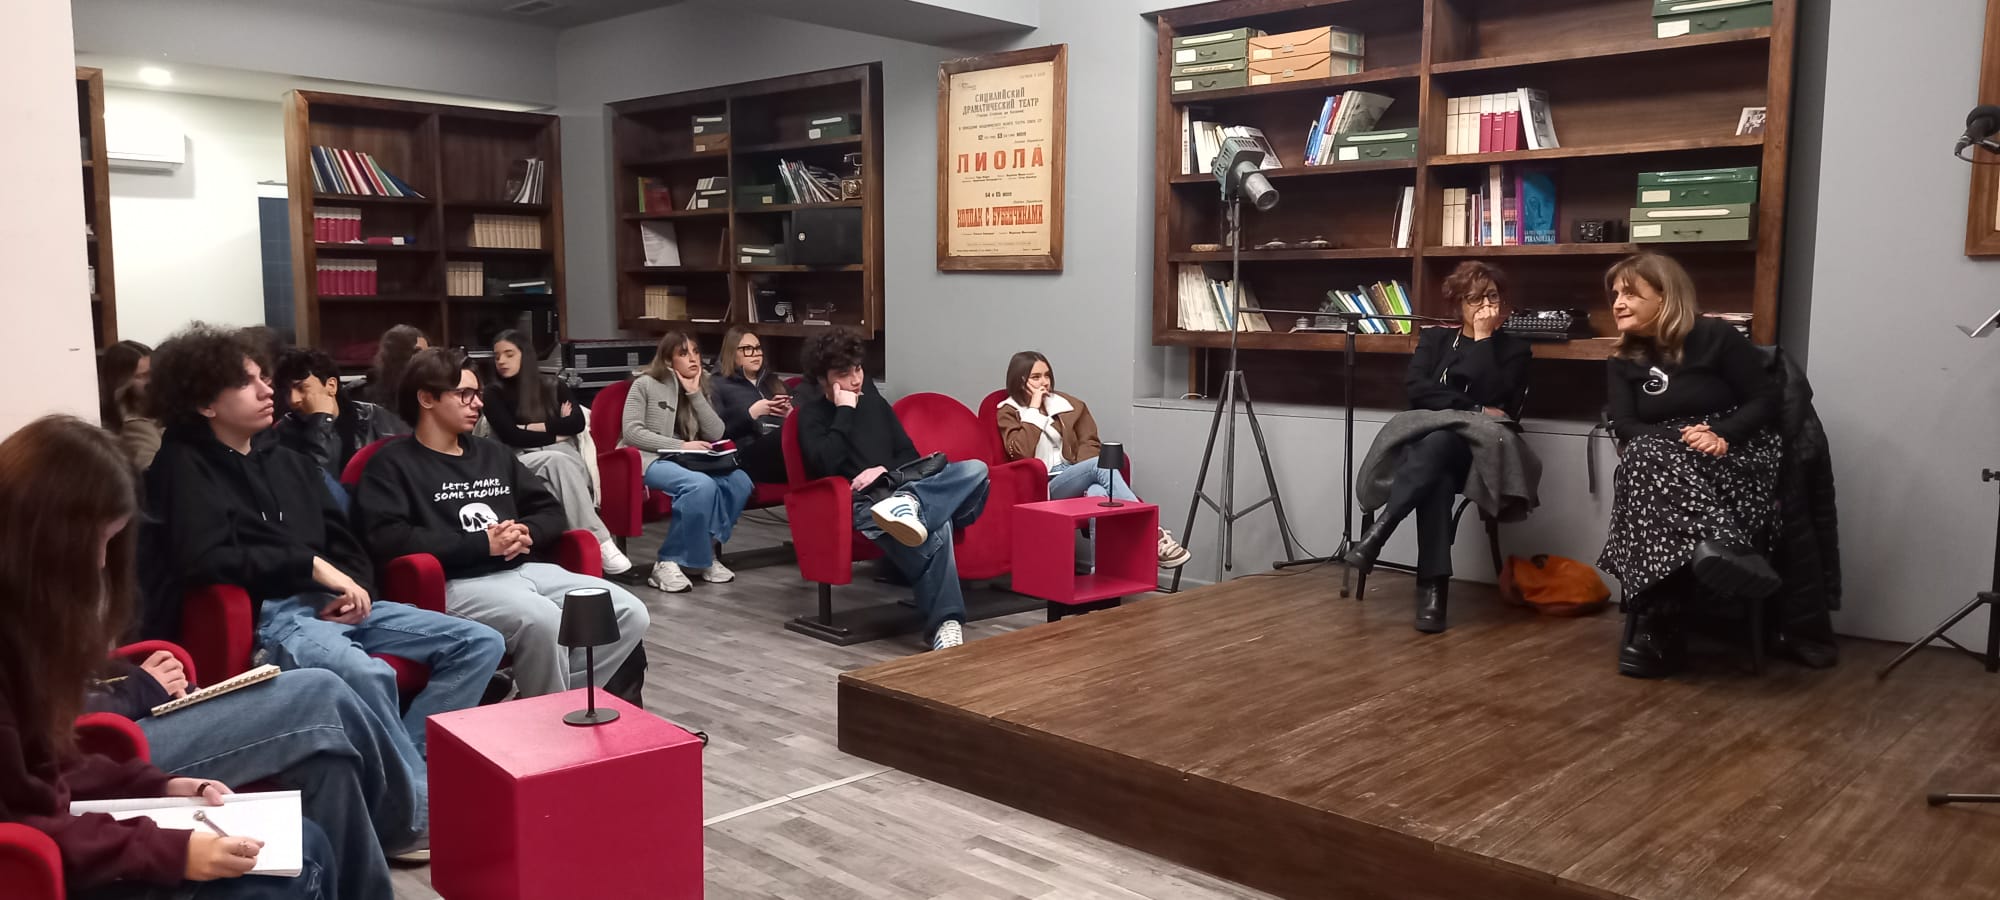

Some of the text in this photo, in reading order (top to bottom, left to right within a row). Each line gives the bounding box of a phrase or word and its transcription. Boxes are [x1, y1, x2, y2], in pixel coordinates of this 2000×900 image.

[962, 98, 1015, 115] ДРАМАТИЧЕСКИЙ
[1018, 97, 1039, 108] ТЕАТР
[957, 147, 1044, 173] ЛИОЛА
[442, 478, 500, 490] LET'S MAKE
[433, 486, 511, 502] SOME TROUBLE
